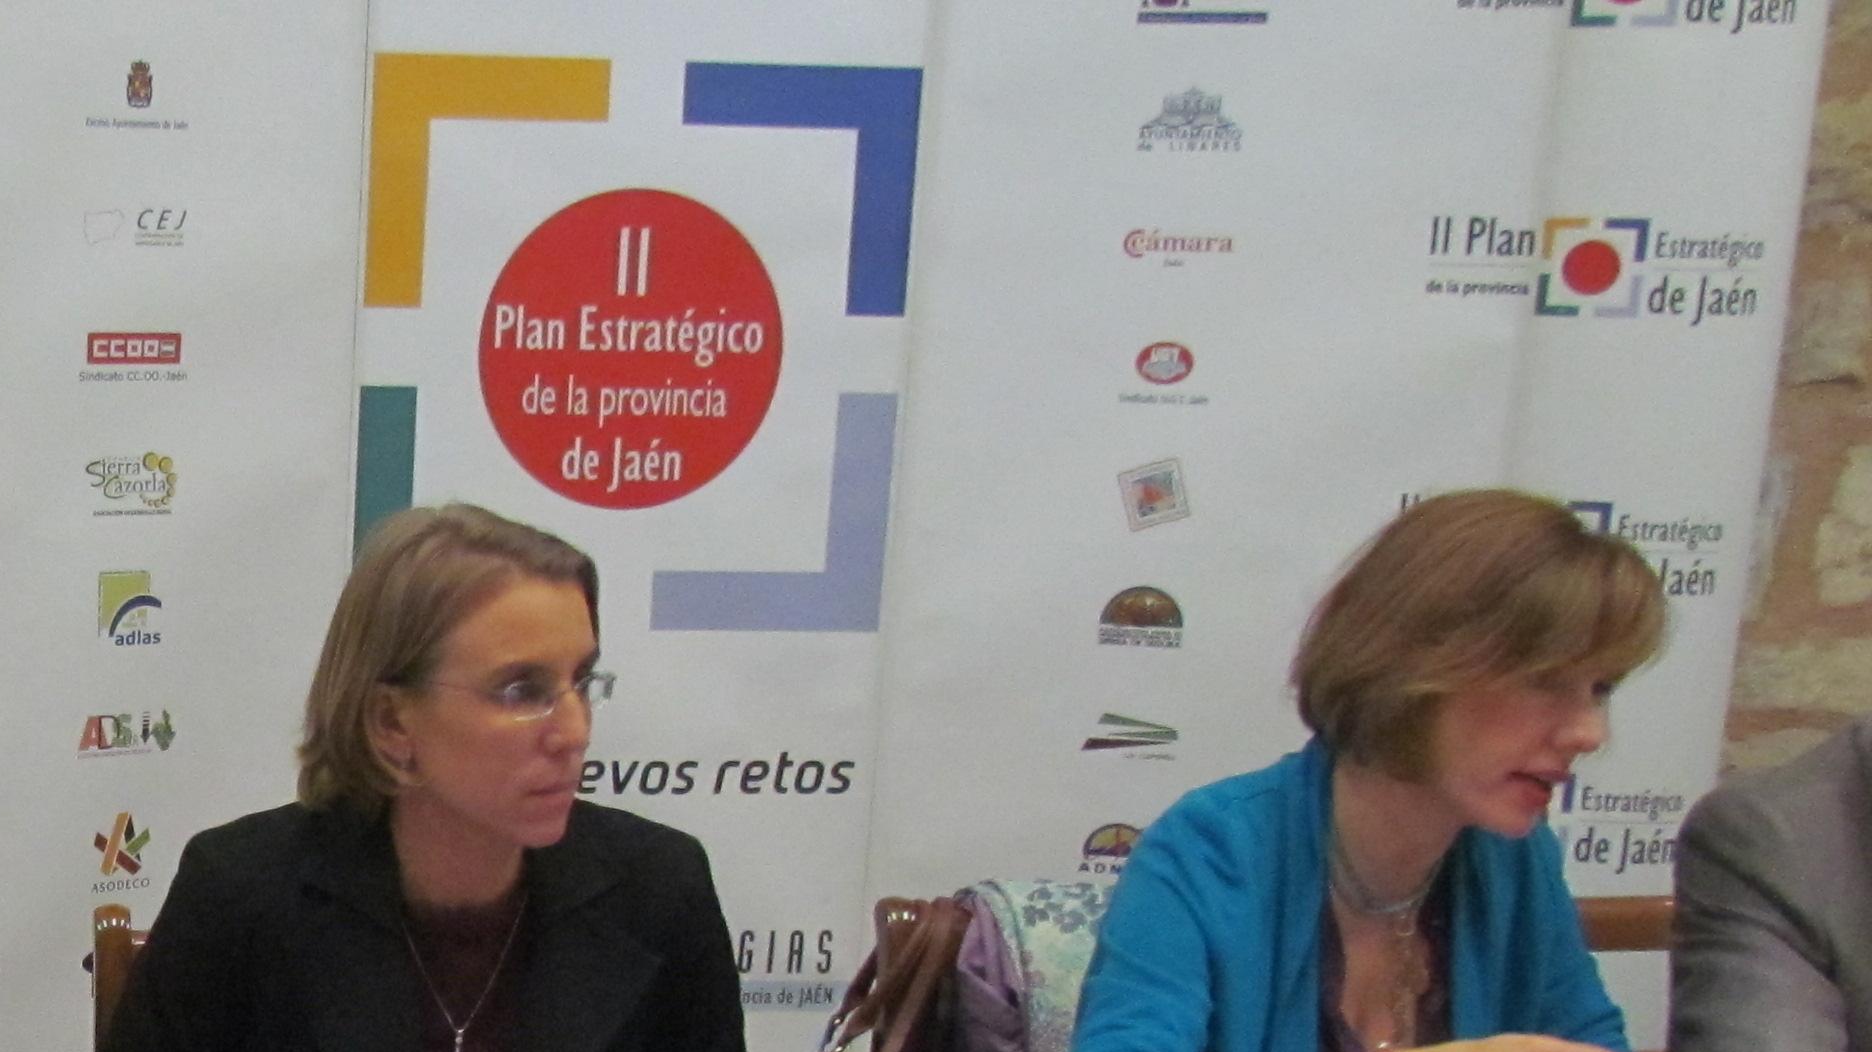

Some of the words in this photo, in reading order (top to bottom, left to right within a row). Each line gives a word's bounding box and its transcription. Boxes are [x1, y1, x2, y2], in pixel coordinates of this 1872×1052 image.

[1430, 215, 1453, 257] II
[1466, 216, 1536, 258] Plan
[1656, 232, 1764, 267] Estratégico
[617, 226, 650, 297] II
[1462, 281, 1529, 298] provincia
[1648, 275, 1685, 314] de
[1690, 275, 1759, 327] Jaén
[494, 304, 565, 350] Plan
[579, 305, 763, 368] Estratégico
[522, 374, 556, 415] de
[567, 374, 589, 415] la
[599, 378, 727, 429] provincia
[85, 459, 140, 488] Sierra
[561, 436, 599, 480] de
[607, 437, 682, 492] Jaén
[103, 473, 166, 499] Cazorla
[1618, 514, 1723, 550] Estratégico
[115, 630, 161, 646] adlas
[578, 760, 699, 795] evos
[713, 751, 855, 795] retos
[1581, 785, 1683, 821] Estratégico
[1575, 826, 1609, 864] de
[1615, 828, 1677, 875] Jaén
[91, 878, 150, 894] ASODECO
[777, 987, 793, 1004] de
